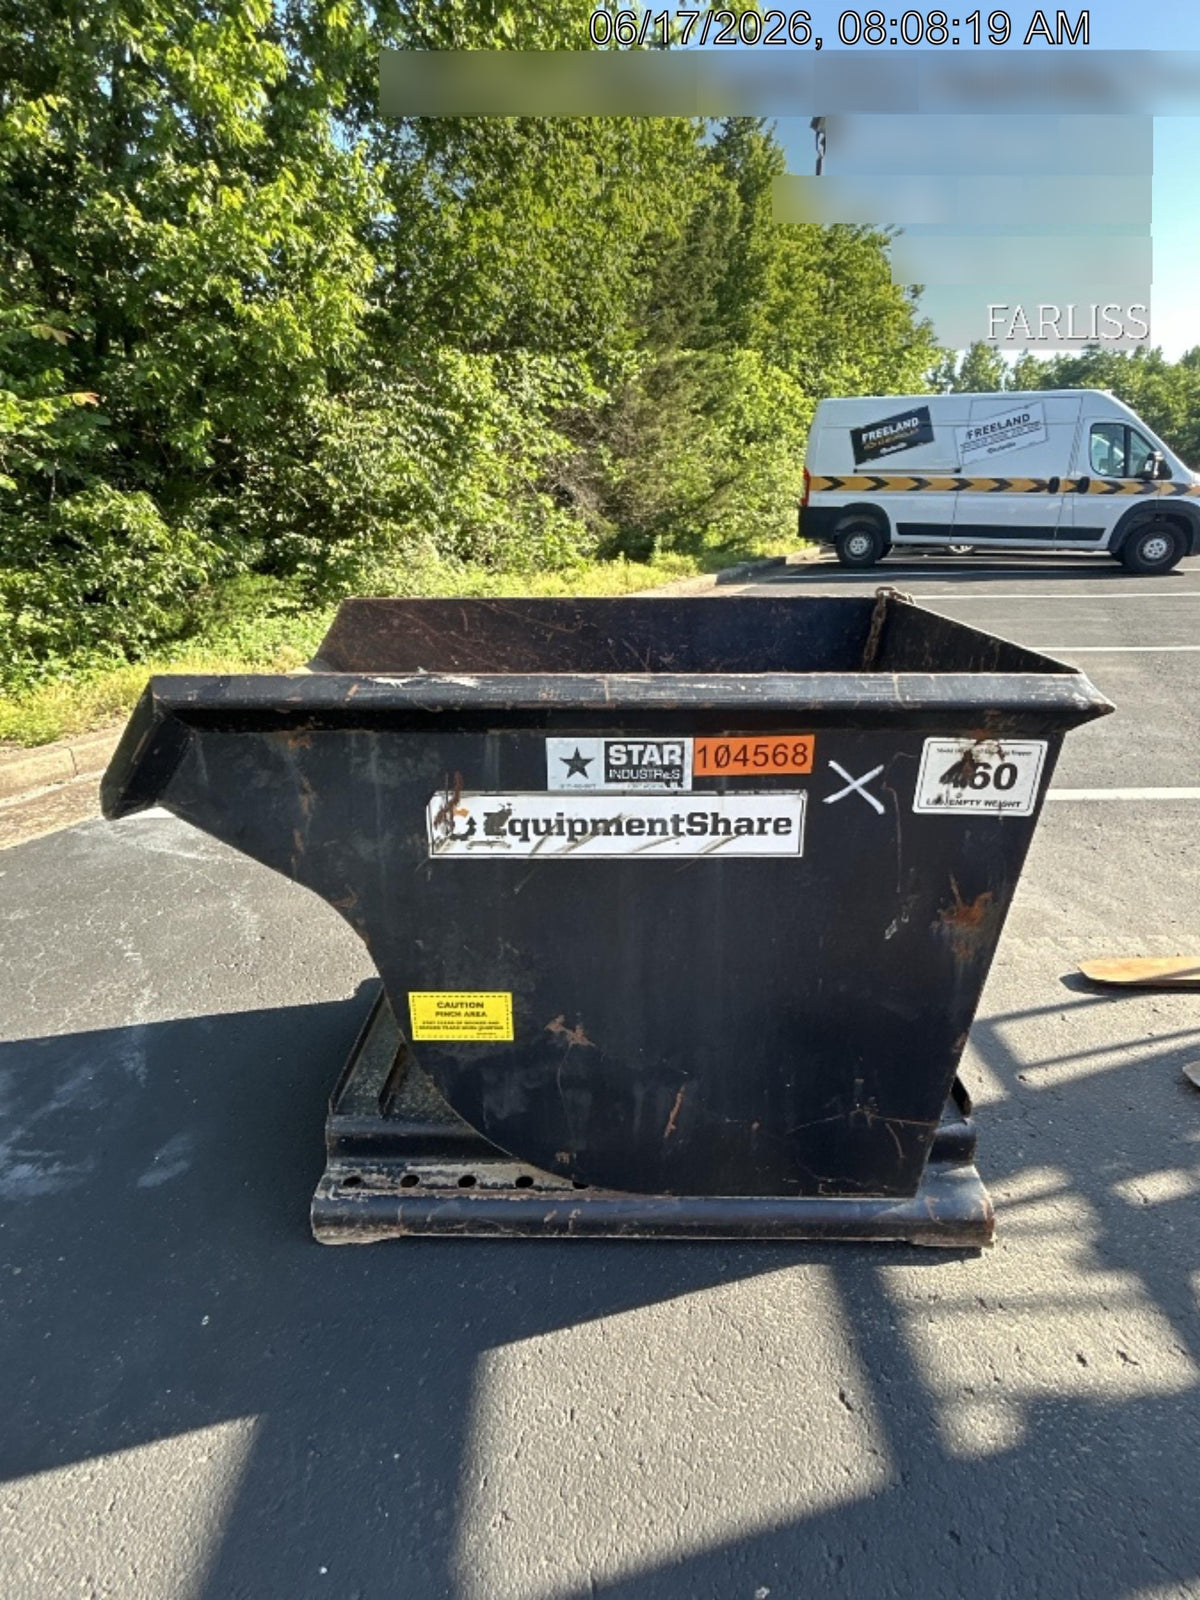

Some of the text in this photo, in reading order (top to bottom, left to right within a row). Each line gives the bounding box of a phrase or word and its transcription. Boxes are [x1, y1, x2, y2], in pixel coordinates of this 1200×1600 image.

[861, 416, 920, 443] FREELAND
[966, 412, 1031, 440] FREELAND
[608, 744, 682, 766] STAR
[696, 742, 809, 770] 104568
[436, 1001, 484, 1009] CAUTION
